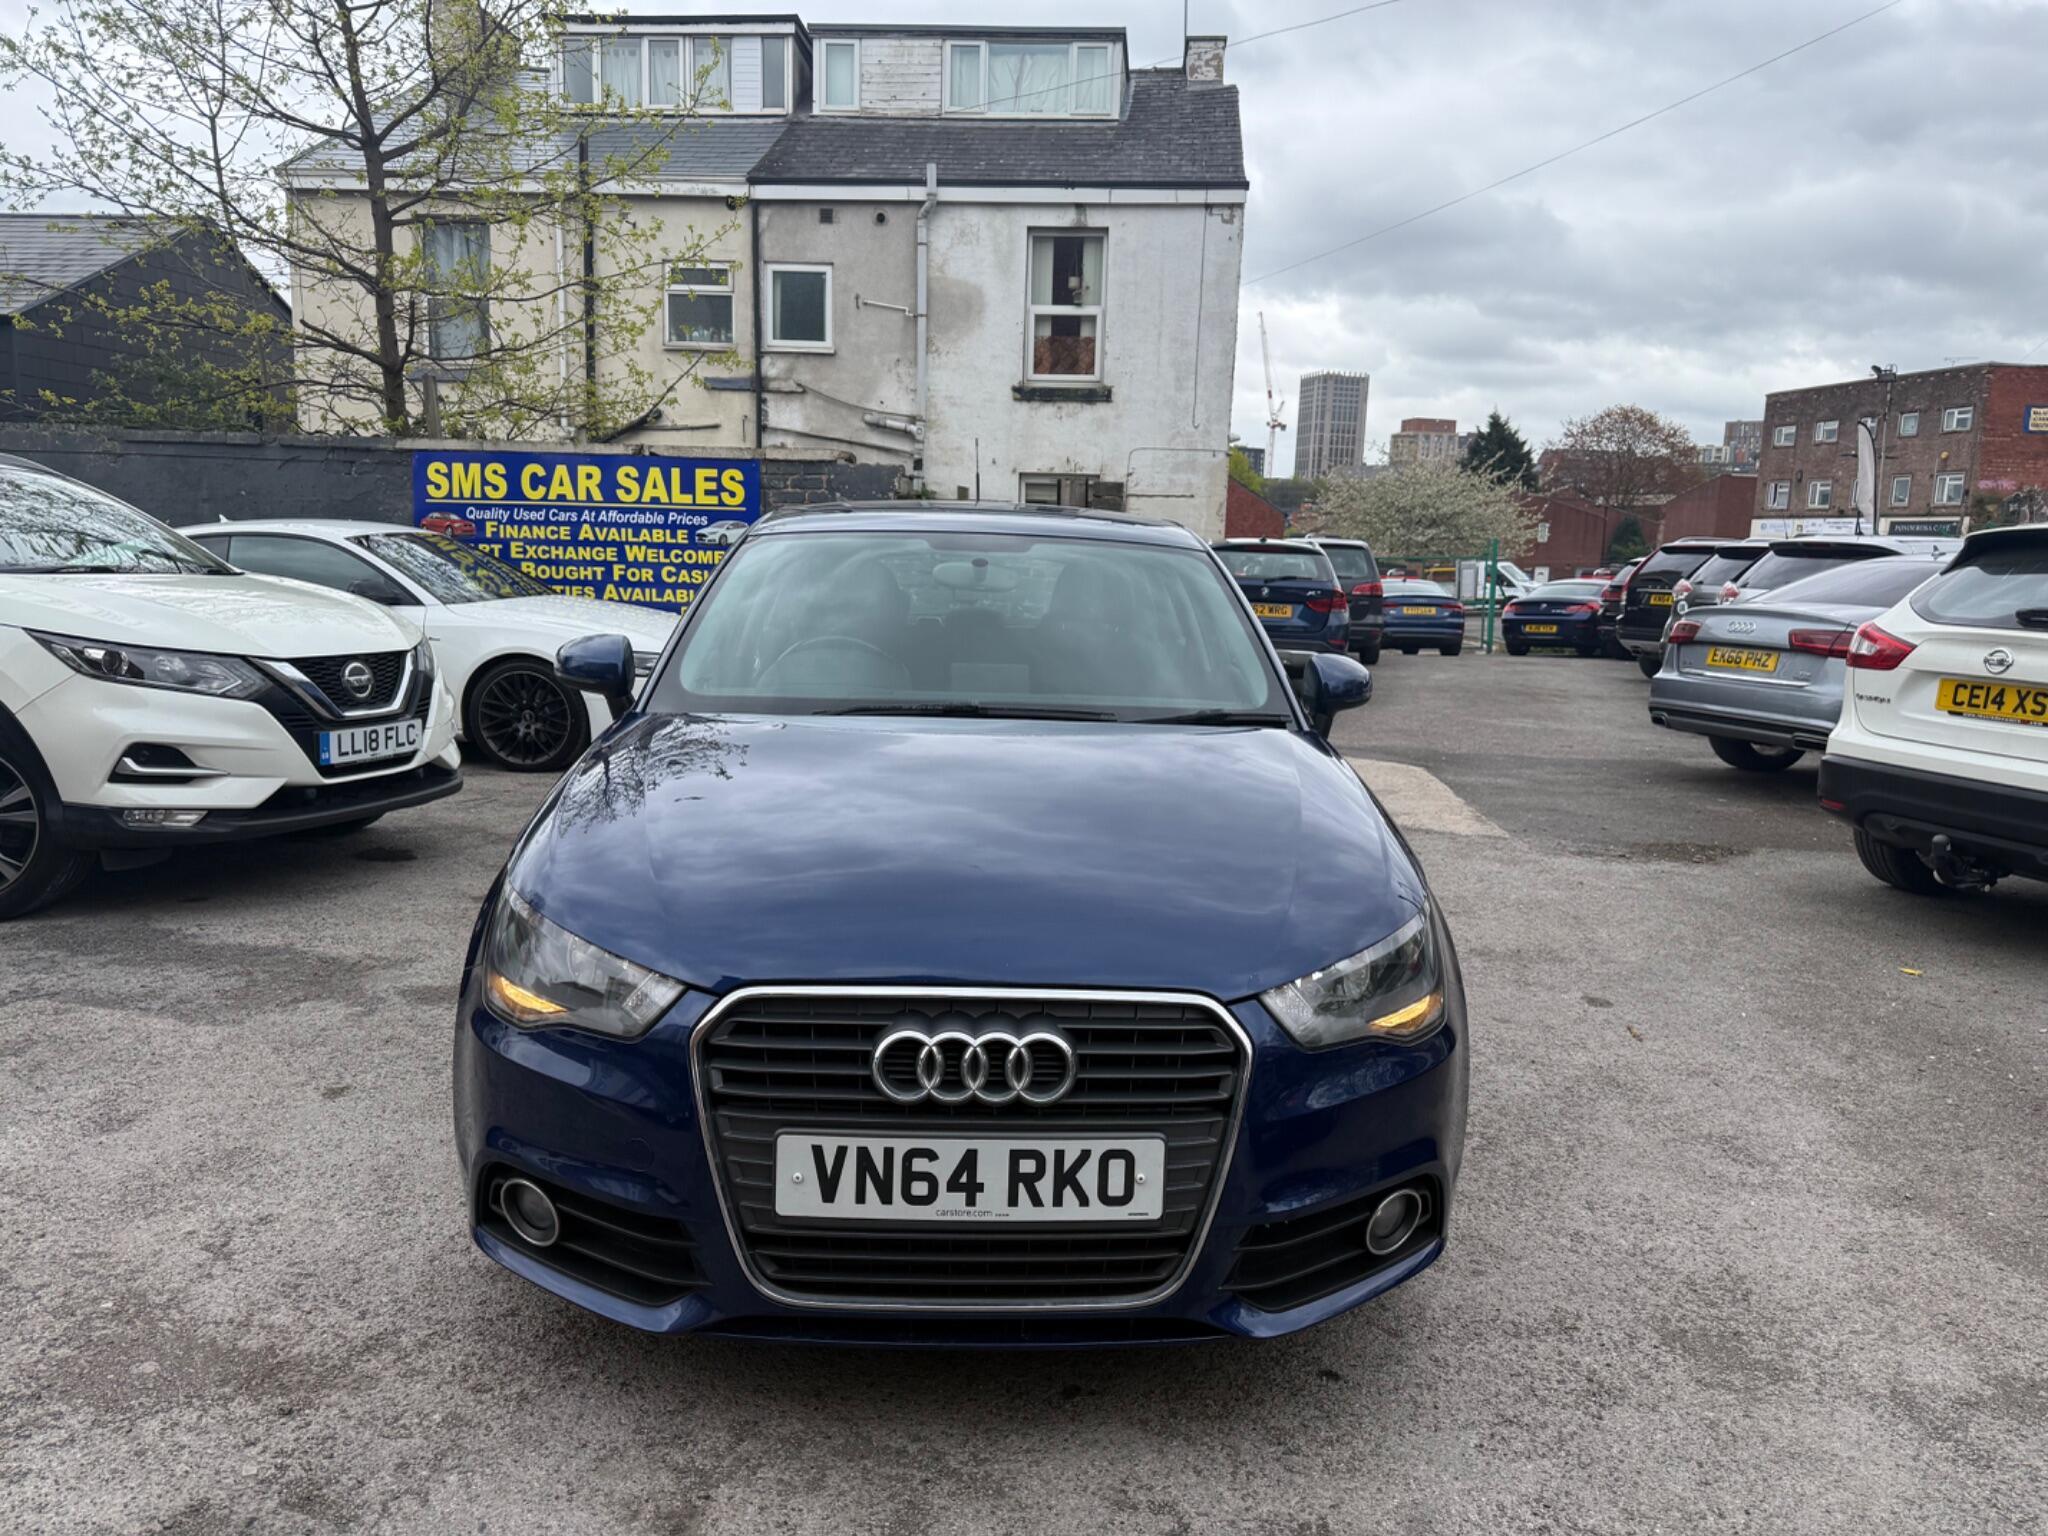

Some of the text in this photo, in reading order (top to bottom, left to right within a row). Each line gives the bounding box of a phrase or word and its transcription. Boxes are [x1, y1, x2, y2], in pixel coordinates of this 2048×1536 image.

[425, 461, 746, 506] SMS CAR SALES
[465, 507, 708, 526] Quality Used Cars At Affordable Prices
[485, 521, 689, 544] FINANCE AVAILABLE
[511, 541, 618, 561] EXCHANGE
[613, 564, 654, 582] FOR
[1711, 647, 1773, 668] EK66 PHZ
[1952, 683, 2005, 711] CE14
[337, 723, 417, 757] LL18 FLC
[811, 1144, 1137, 1209] VN64 RKO
[935, 1209, 993, 1218] carstore.com
